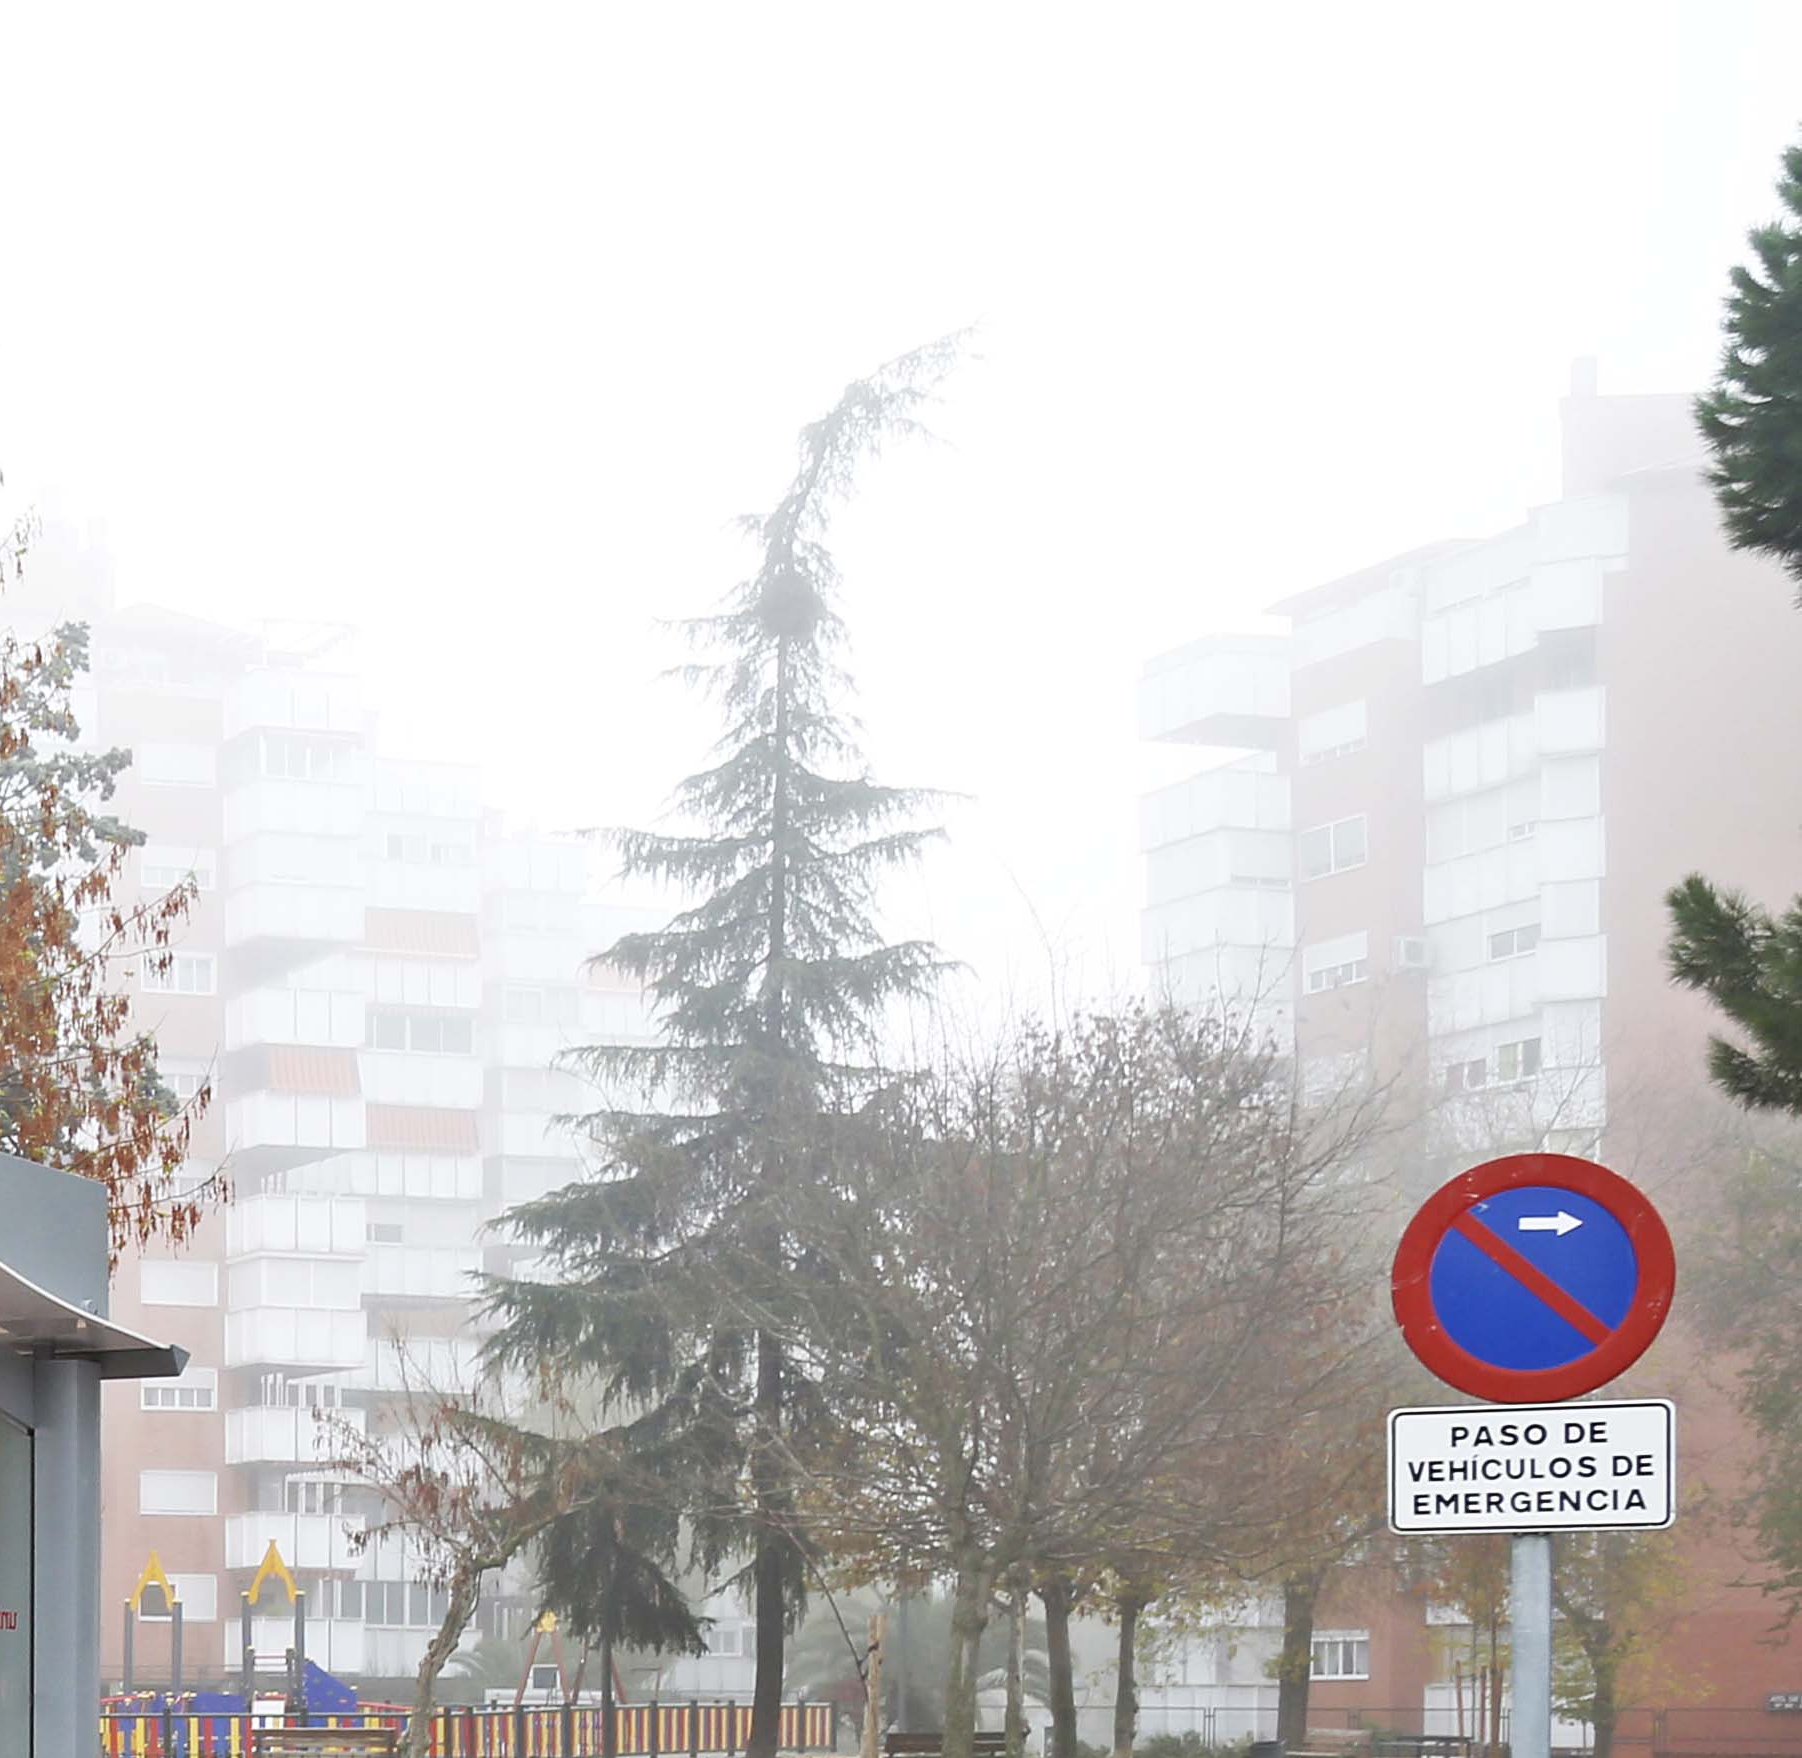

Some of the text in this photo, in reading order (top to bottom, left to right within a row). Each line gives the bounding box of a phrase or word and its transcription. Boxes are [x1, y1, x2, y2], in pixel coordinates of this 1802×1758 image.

[1450, 1421, 1609, 1448] PASO DE
[1407, 1454, 1655, 1483] VEHÍCULOS DE
[1412, 1488, 1648, 1516] EMERGENCIA
